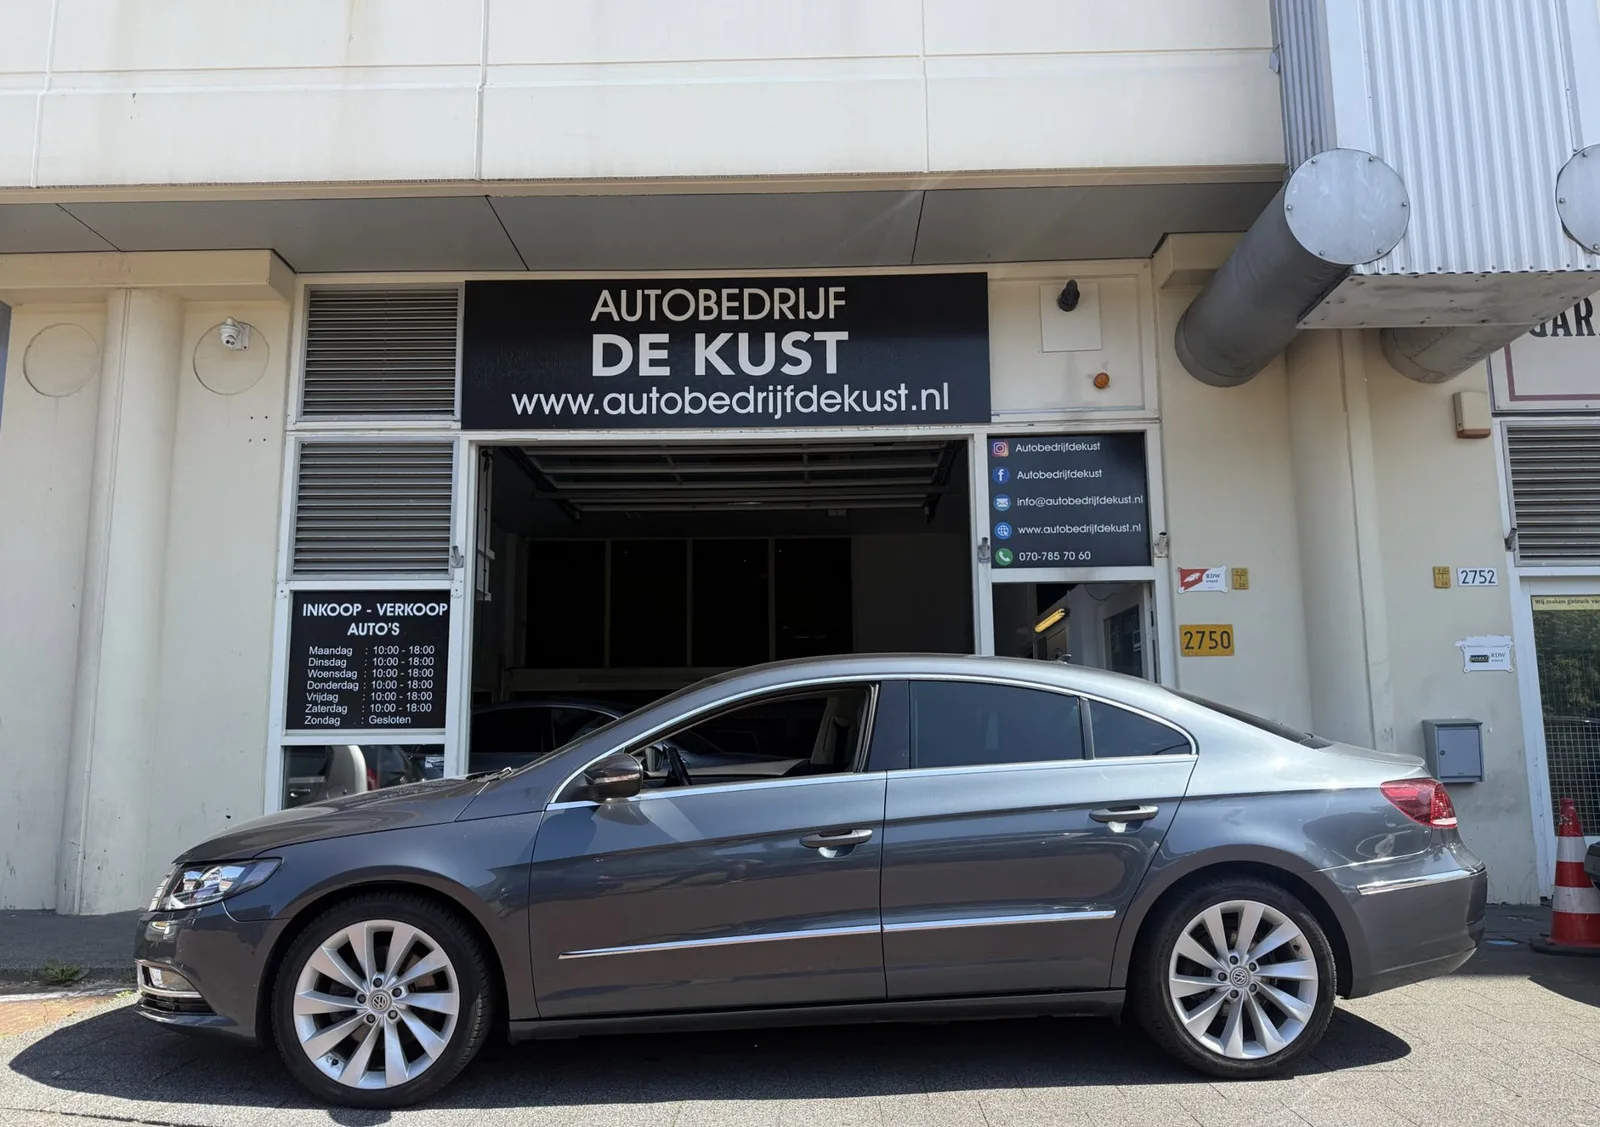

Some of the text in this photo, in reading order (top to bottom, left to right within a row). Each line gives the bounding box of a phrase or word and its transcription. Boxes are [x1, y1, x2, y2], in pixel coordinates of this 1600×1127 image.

[591, 287, 845, 321] AUTOBEDRIJF
[593, 331, 848, 376] DE KUST
[512, 382, 948, 419] www.autobedrijfdekust.nl
[1016, 442, 1100, 452] Autobedrijfdekust
[1017, 469, 1102, 480] Autobedrijfdekust
[1017, 495, 1143, 507] info@autobedrijfdekust.nl
[1018, 524, 1141, 534] www.autobedrijfdekust.nl
[1019, 551, 1091, 561] 070-785 70 60
[1461, 570, 1495, 584] 2752
[303, 604, 361, 616] INKOOP
[377, 603, 447, 616] VERKOOP
[347, 623, 399, 635] AUTO'S
[1183, 630, 1231, 650] 2750
[309, 646, 352, 655] Maandag
[374, 646, 399, 654] 10:00
[409, 646, 434, 654] 18:00
[309, 658, 346, 667] Dinsdag
[373, 657, 398, 666] 10:00
[409, 657, 434, 665] 18:00
[308, 669, 357, 679] Woensdag
[372, 669, 398, 677] 10:00
[408, 669, 433, 677] 18:00
[307, 681, 358, 691] Donderdag
[372, 680, 397, 689] 10:00
[407, 680, 433, 689] 18:00
[307, 693, 338, 703] Vrijdag
[371, 692, 396, 700] 10:00
[407, 692, 432, 700] 18:00
[305, 704, 347, 714] Zaterdag
[370, 704, 396, 712] 10:00
[406, 703, 431, 712] 18:00
[305, 716, 340, 726] Zondag
[369, 715, 411, 724] Gesloten
